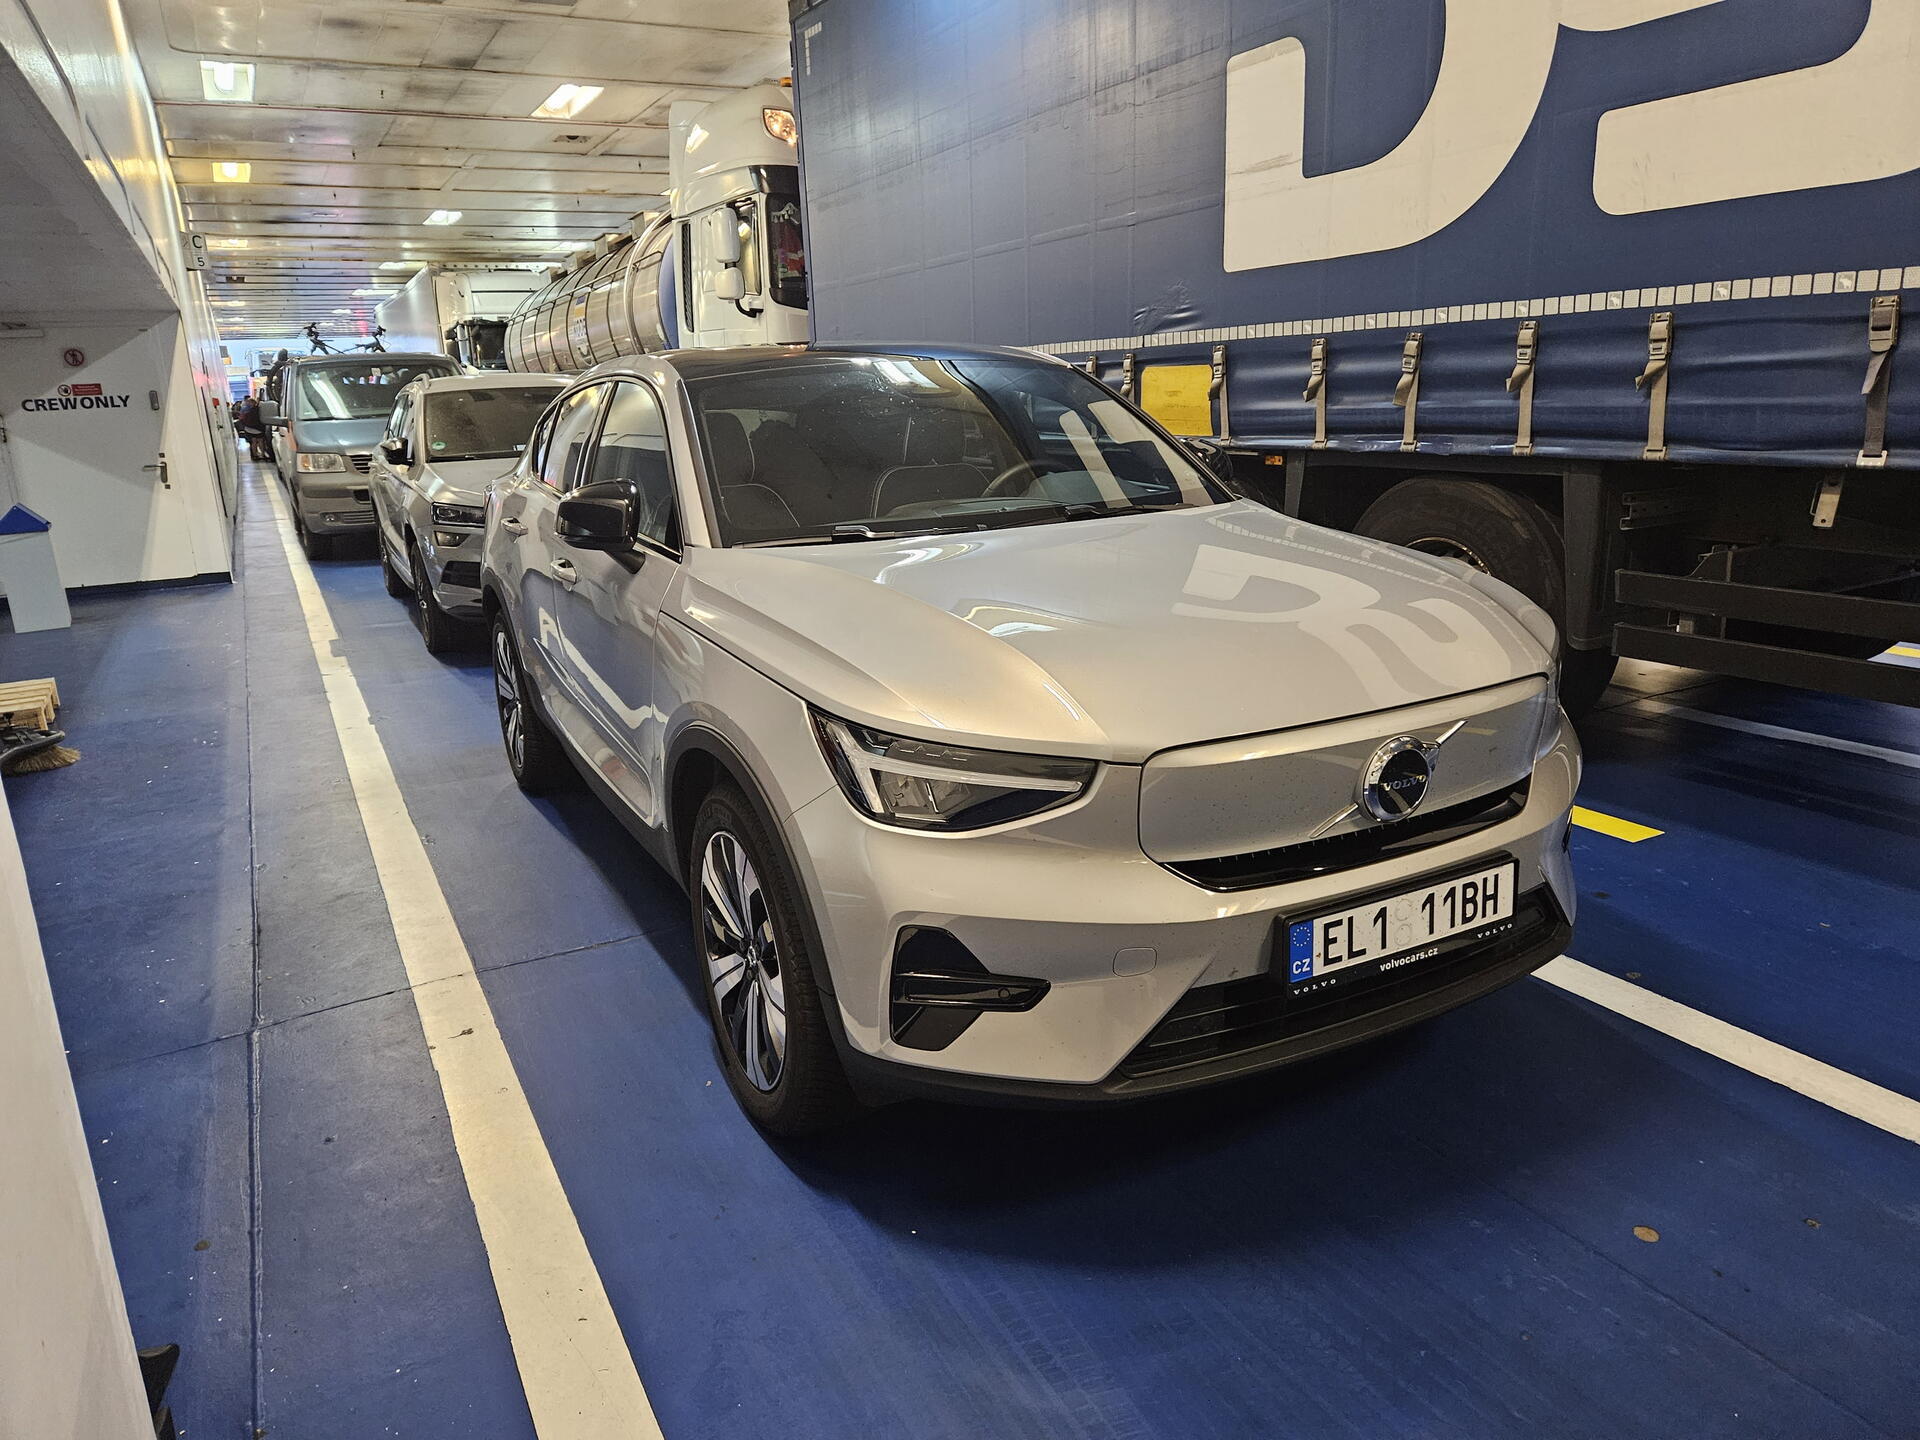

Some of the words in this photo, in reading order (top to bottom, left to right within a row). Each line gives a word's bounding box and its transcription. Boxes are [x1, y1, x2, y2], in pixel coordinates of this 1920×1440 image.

[191, 234, 203, 249] C
[197, 256, 205, 267] 5
[21, 397, 77, 412] CREW
[79, 395, 130, 409] ONLY
[1380, 774, 1427, 791] VOLVO
[1323, 906, 1388, 967] EL1
[1421, 873, 1499, 936] 11BH
[1477, 923, 1514, 939] VOLVO
[1292, 957, 1311, 975] CZ
[1379, 947, 1439, 972] volvocars.cz
[1293, 978, 1337, 995] VOLVO
